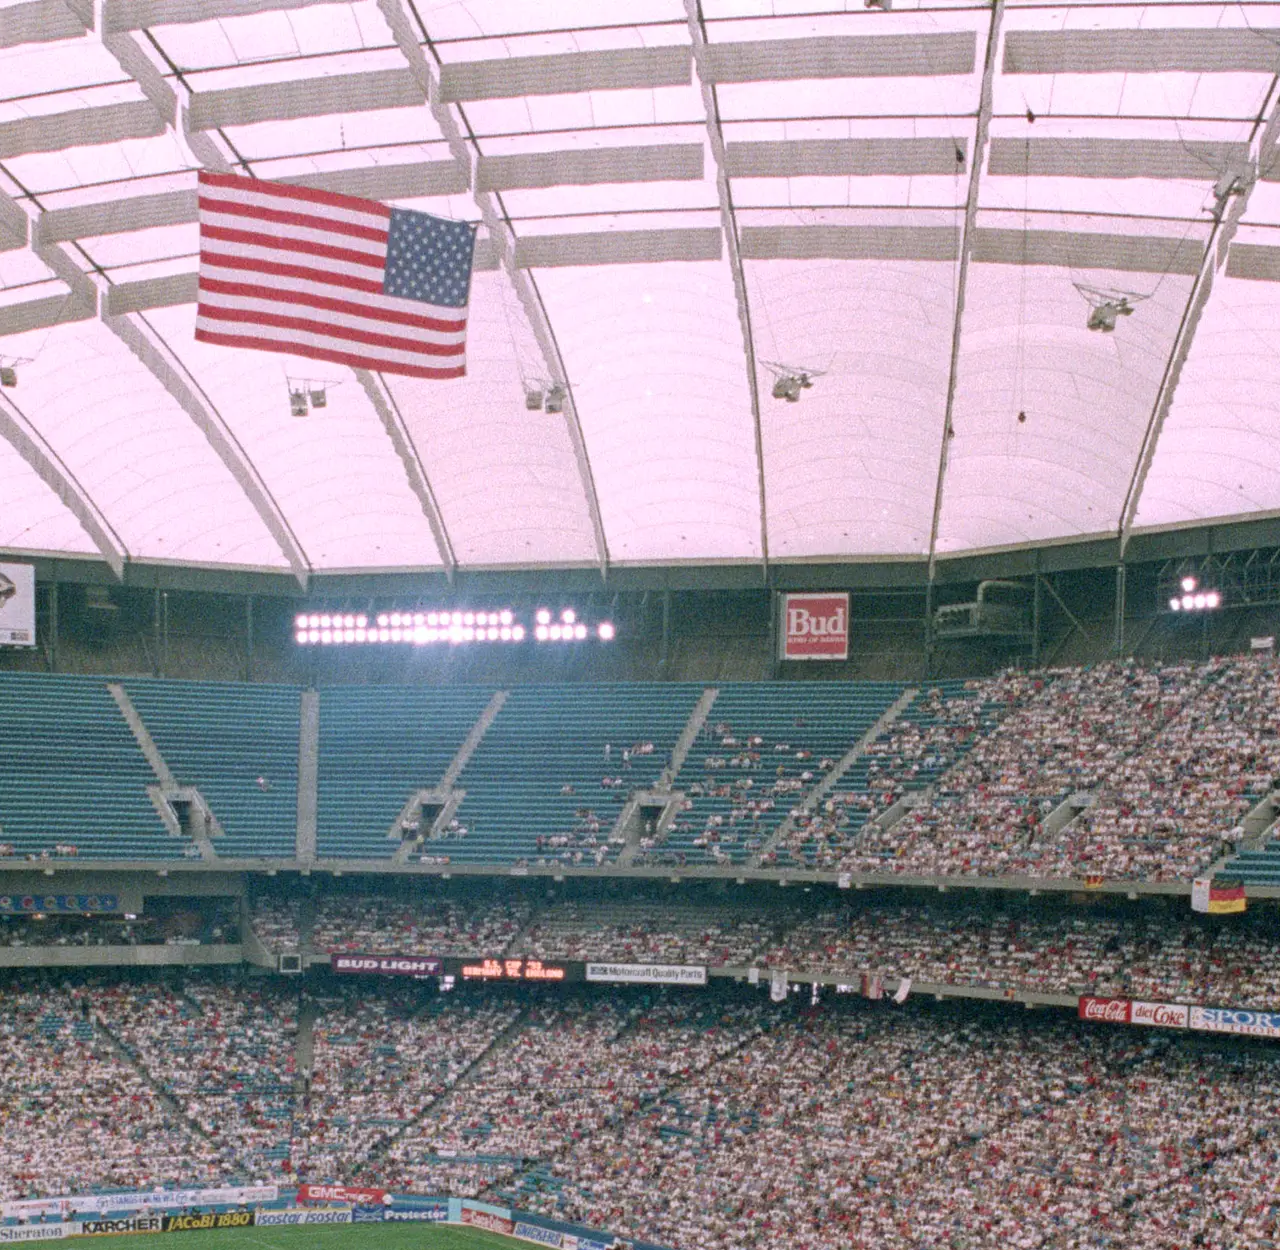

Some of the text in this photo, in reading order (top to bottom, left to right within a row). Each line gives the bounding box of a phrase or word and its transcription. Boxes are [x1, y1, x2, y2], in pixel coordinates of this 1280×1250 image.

[788, 607, 847, 635] Bud
[336, 958, 439, 972] BUD LIGHT
[462, 966, 502, 977] GERMANY
[525, 968, 564, 979] ENGLAND
[609, 967, 651, 977] Motorcraft
[652, 968, 679, 980] Quality
[680, 970, 703, 979] Parts
[1135, 1004, 1153, 1019] diet
[1153, 1006, 1185, 1026] Coke
[308, 1187, 345, 1200] GMC
[218, 1213, 250, 1228] 1880
[257, 1209, 350, 1225] isostar isostar
[383, 1207, 447, 1221] Protector
[0, 1226, 63, 1241] Sheraton
[515, 1223, 562, 1247] SNICKERS
